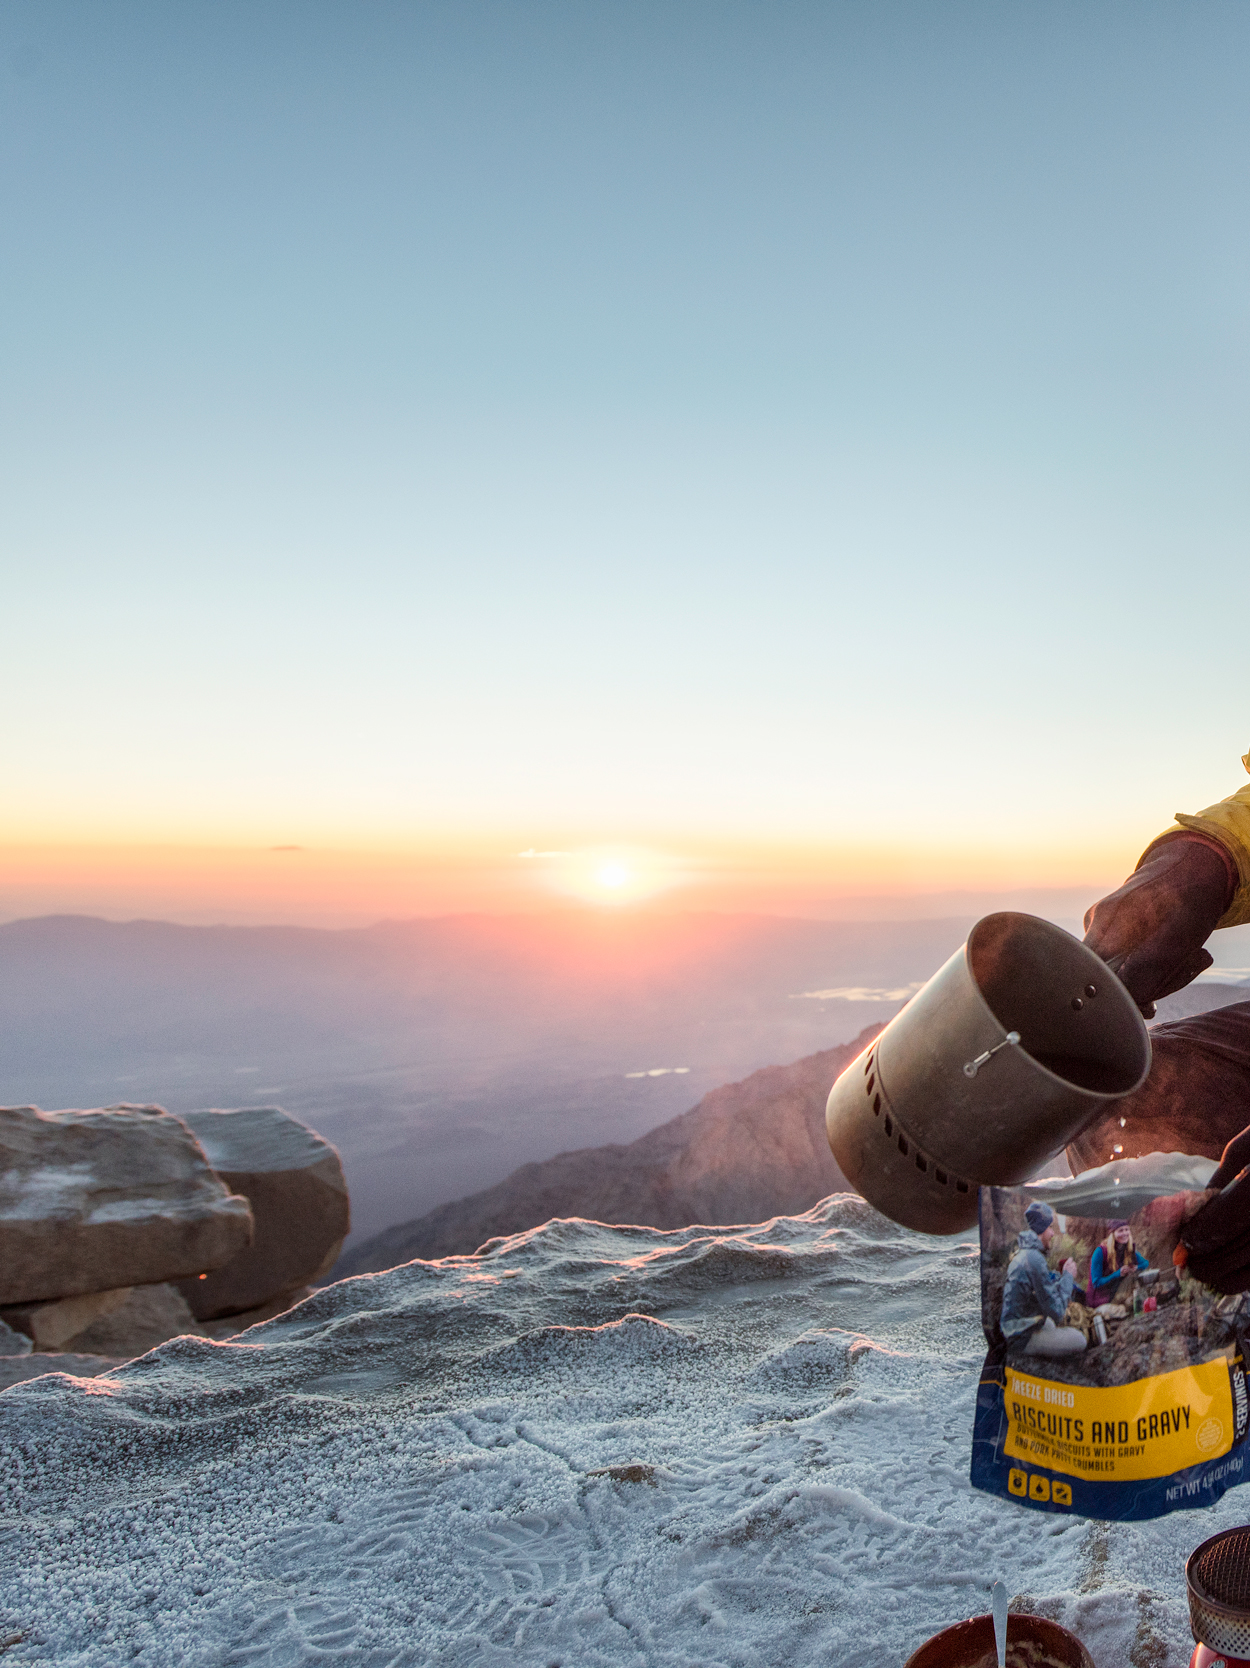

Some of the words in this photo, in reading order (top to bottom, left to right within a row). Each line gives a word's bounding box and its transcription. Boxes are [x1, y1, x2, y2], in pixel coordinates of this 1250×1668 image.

[1044, 1387, 1075, 1408] DRIED
[1233, 1370, 1248, 1430] SERVINGS
[1012, 1401, 1084, 1442] BISCUITS
[1092, 1421, 1129, 1444] AND
[1137, 1404, 1191, 1441] GRAVY
[1029, 1440, 1050, 1457] PORK
[1073, 1458, 1115, 1472] CRUMBLES
[1093, 1445, 1116, 1458] WITH
[1118, 1445, 1146, 1458] GRAVY
[1166, 1483, 1186, 1501] NET
[1185, 1480, 1201, 1496] WT
